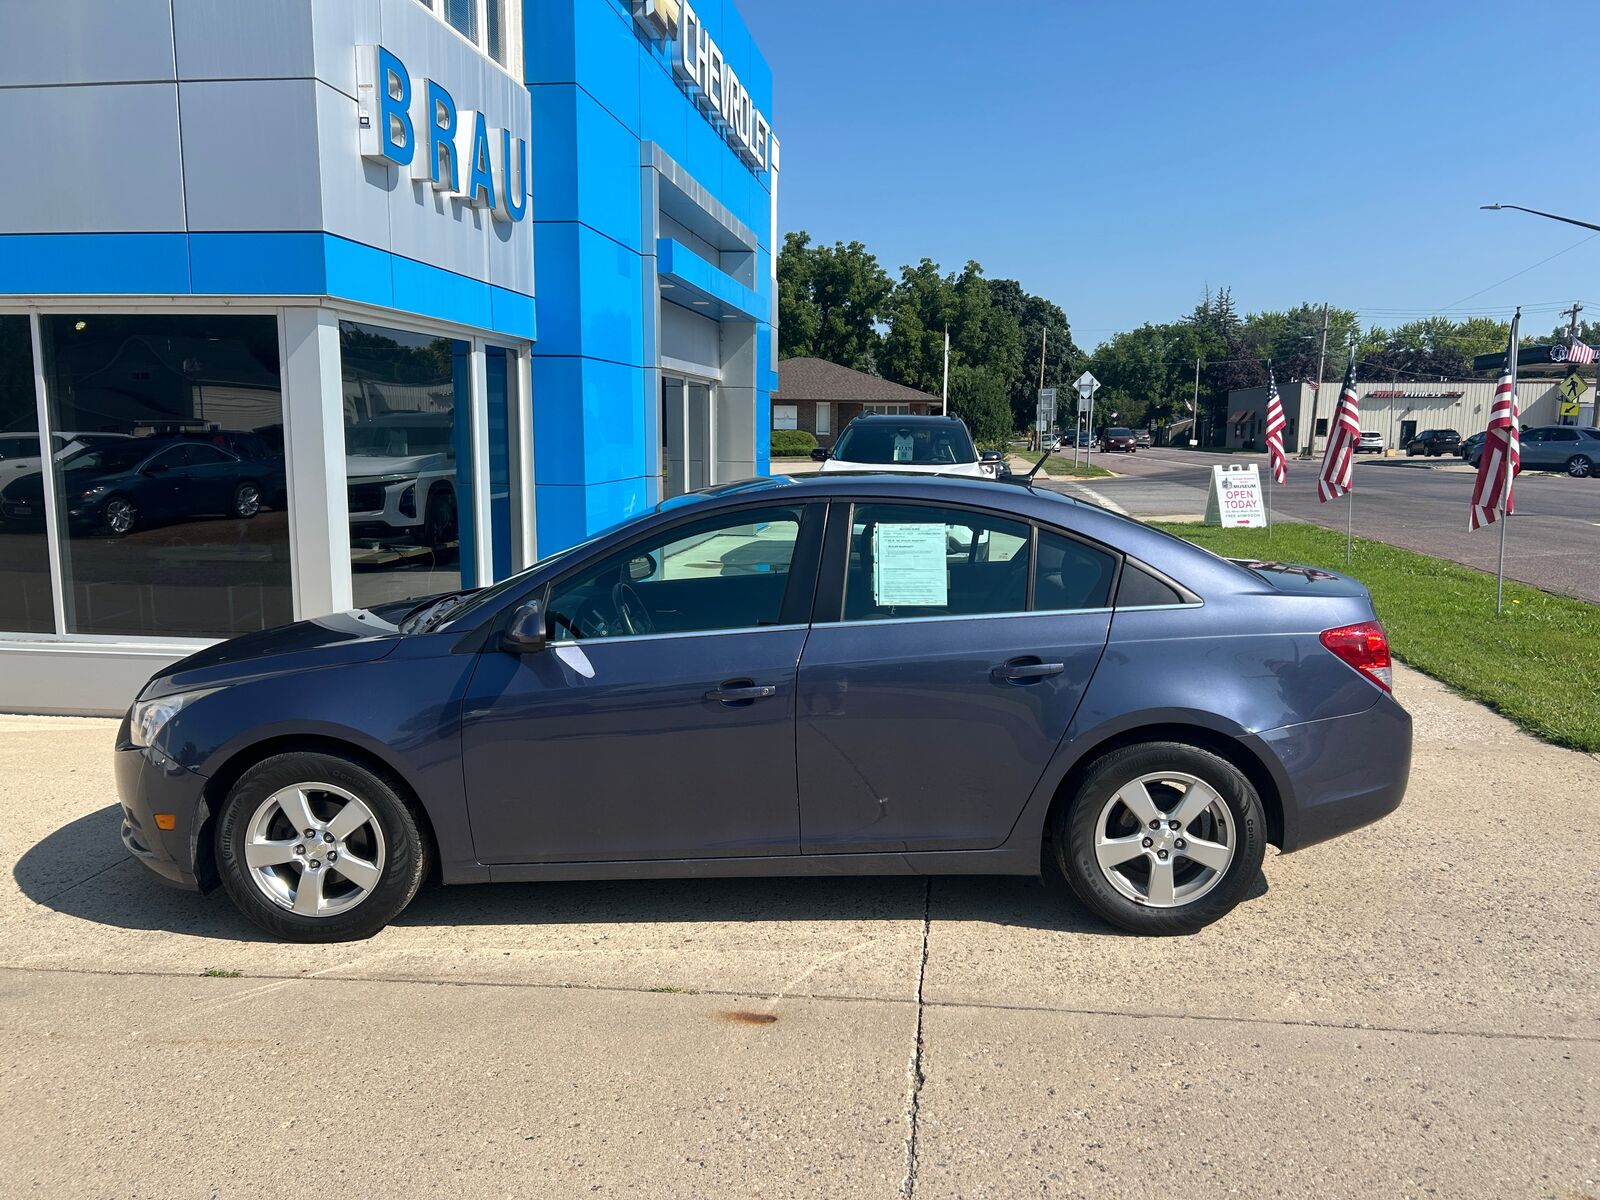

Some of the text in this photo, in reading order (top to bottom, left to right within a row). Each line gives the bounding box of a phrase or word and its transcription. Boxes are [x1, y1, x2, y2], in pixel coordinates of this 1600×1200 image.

[683, 0, 770, 173] CHEVROLET
[378, 44, 528, 223] BRAU
[1224, 500, 1257, 509] TODAY
[1226, 490, 1254, 500] OPEN
